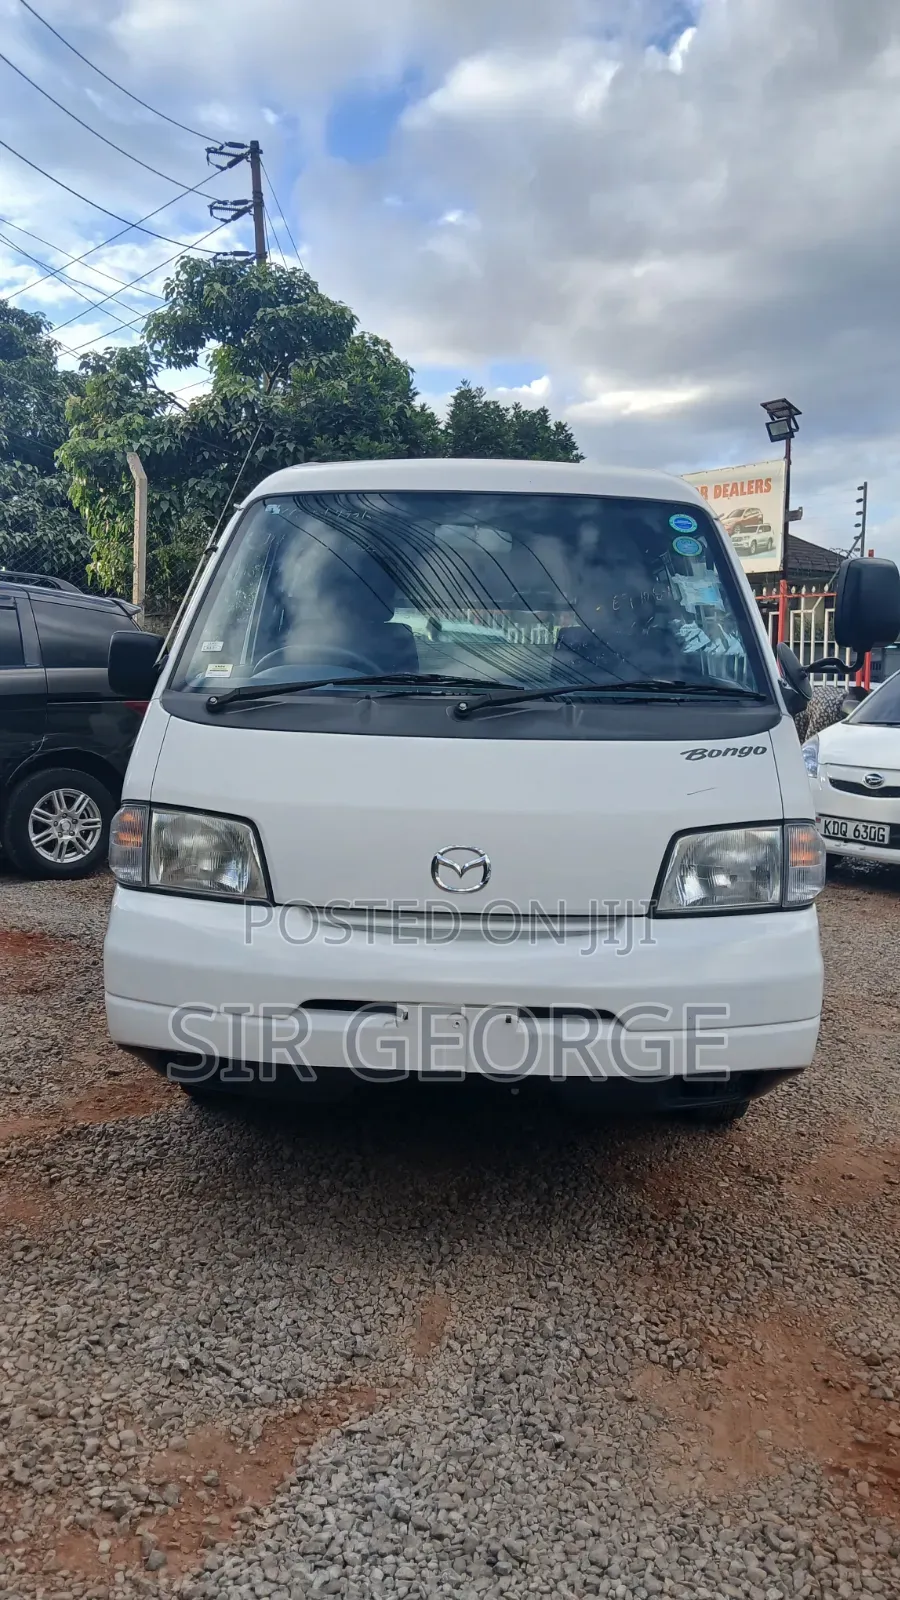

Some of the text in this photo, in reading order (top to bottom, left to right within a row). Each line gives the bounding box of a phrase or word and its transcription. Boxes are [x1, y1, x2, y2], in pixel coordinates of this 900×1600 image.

[695, 477, 772, 500] R DEALERS
[679, 745, 768, 761] Bongo
[823, 819, 886, 843] KDQ 630G
